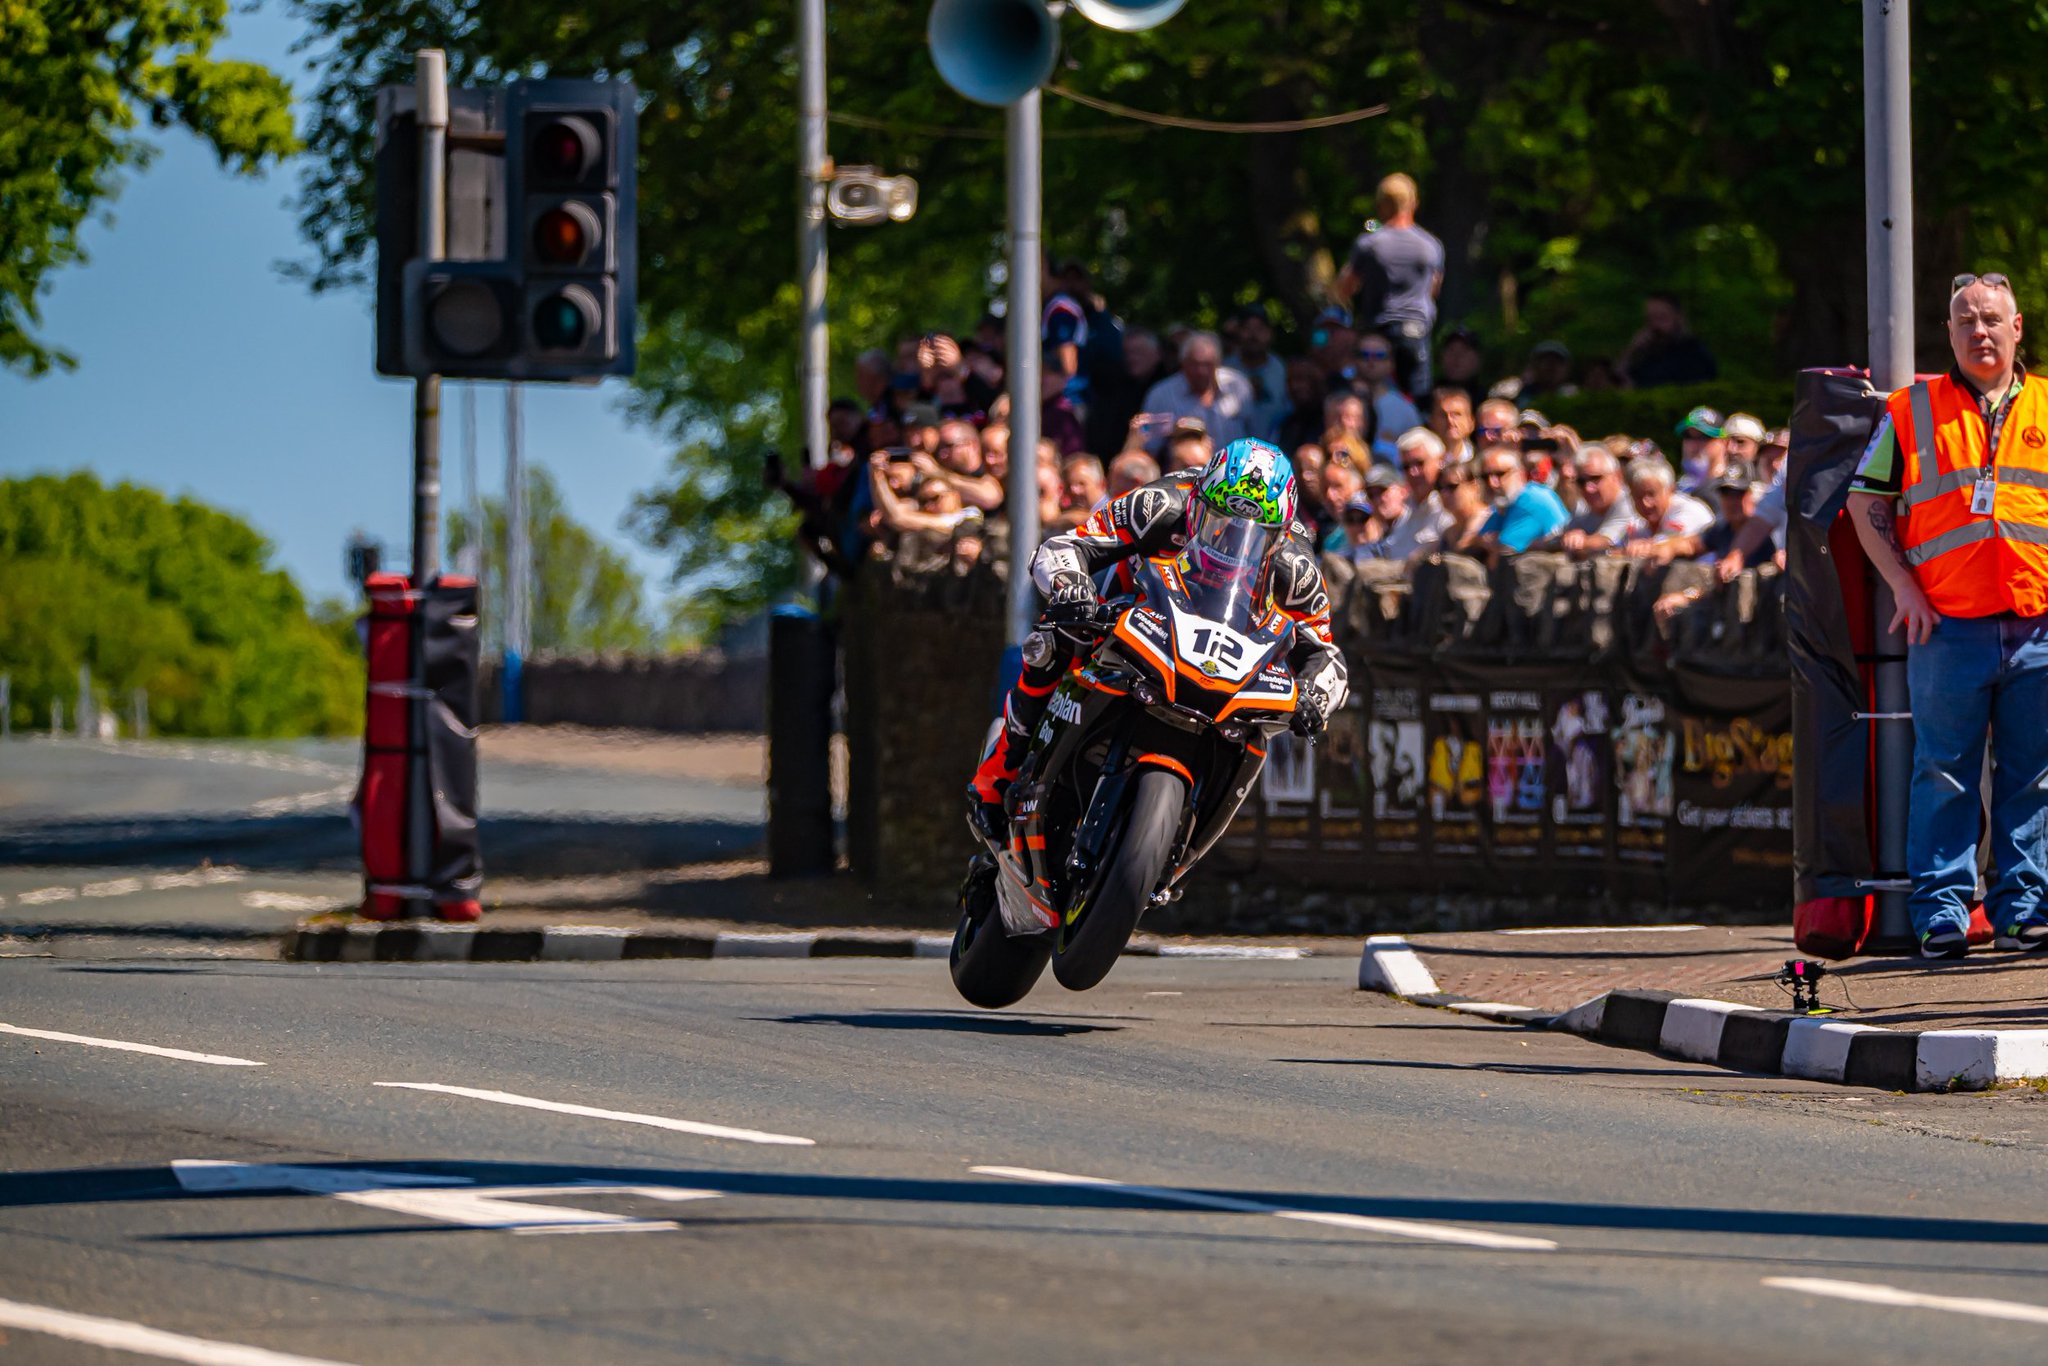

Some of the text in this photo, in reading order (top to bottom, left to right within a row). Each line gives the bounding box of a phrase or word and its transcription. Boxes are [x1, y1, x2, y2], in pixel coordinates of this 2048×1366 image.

[1134, 612, 1169, 640] Steadplan
[1192, 628, 1244, 671] 12
[1258, 672, 1291, 686] Steadplan
